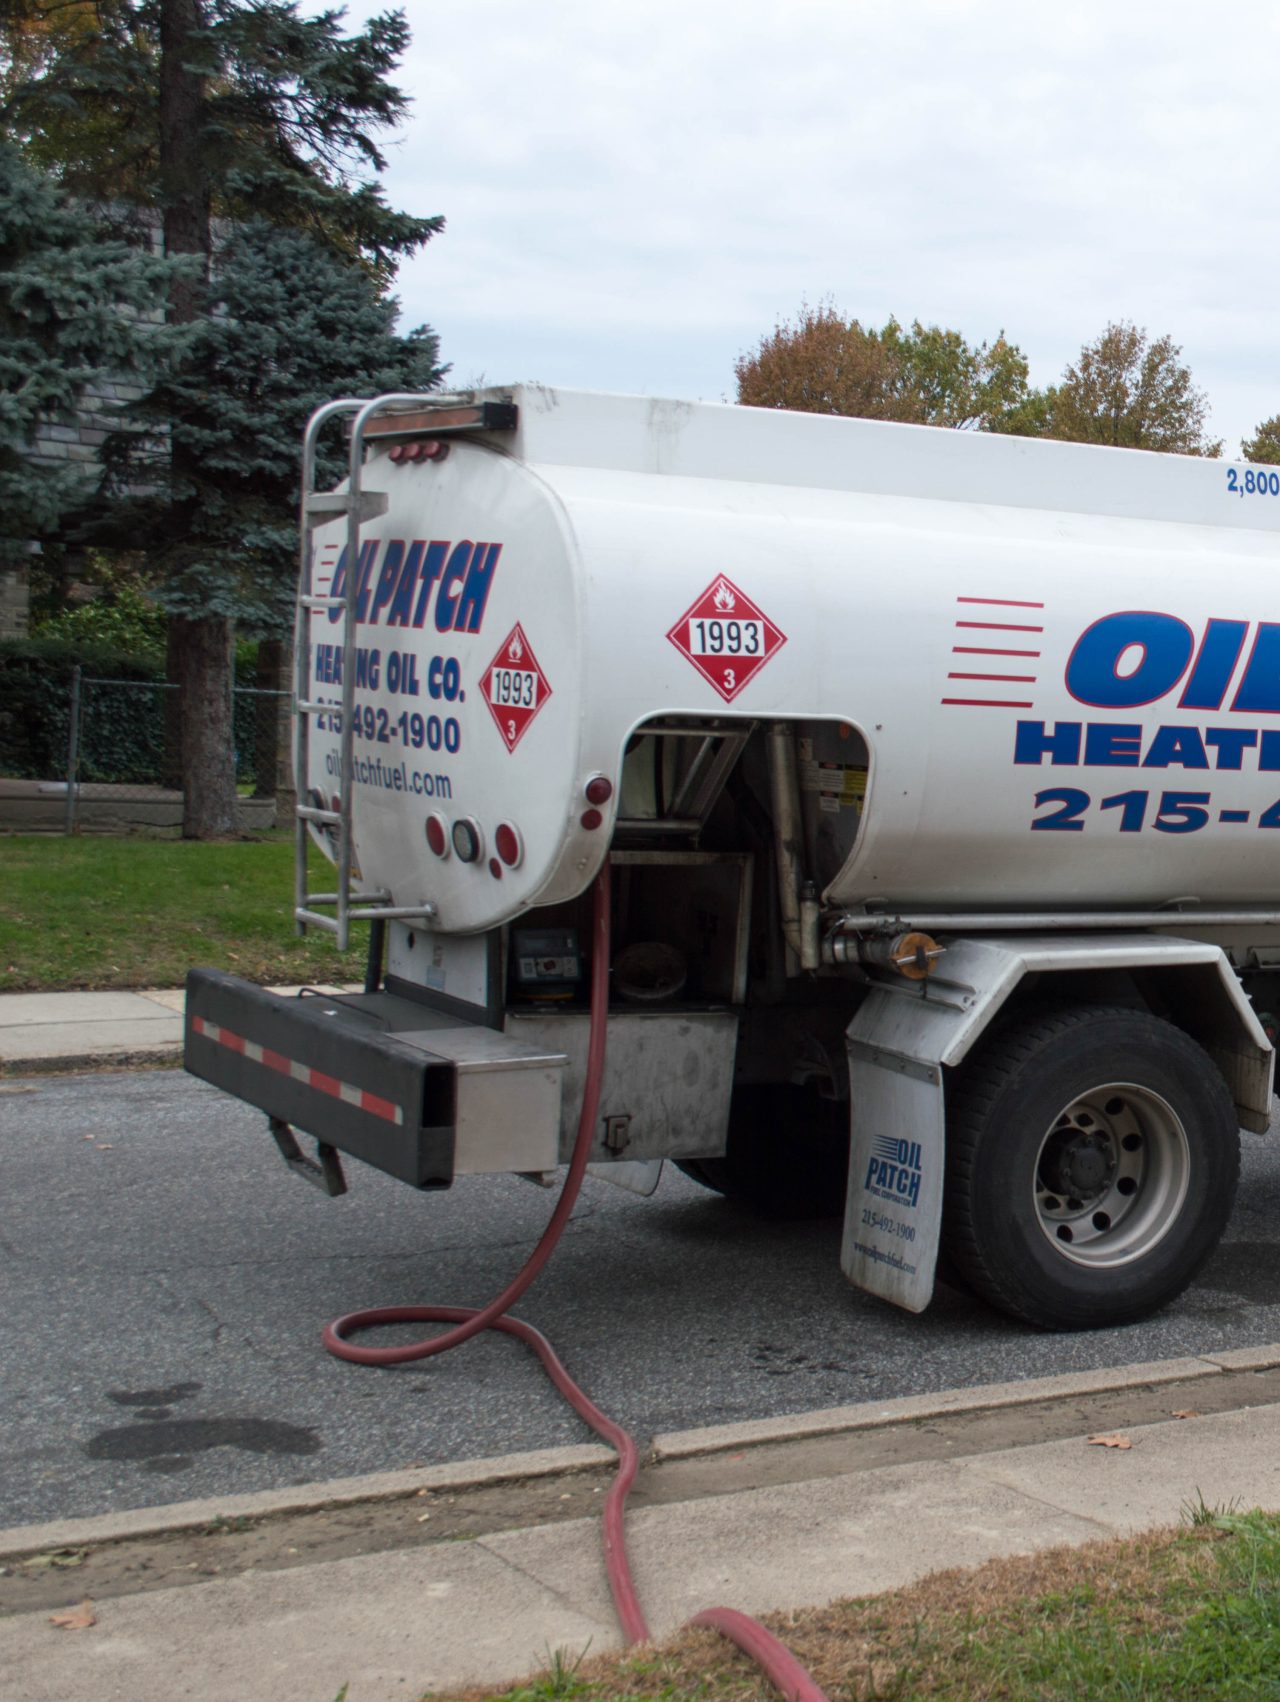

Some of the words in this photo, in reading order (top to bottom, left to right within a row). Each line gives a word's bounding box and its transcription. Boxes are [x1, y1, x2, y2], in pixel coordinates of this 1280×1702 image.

[1227, 468, 1280, 498] 2,800
[368, 539, 503, 634] PATCH
[695, 621, 759, 655] 1993
[316, 643, 381, 692] HEANG
[387, 650, 420, 696] OIL
[428, 655, 466, 703] CO.
[495, 670, 533, 706] 1993
[723, 668, 736, 689] 3
[317, 696, 462, 754] 215492-1900
[507, 719, 517, 740] 3
[897, 1139, 922, 1171] OIL
[864, 1156, 922, 1208] PATCH
[862, 1208, 916, 1242] 215-492-1900
